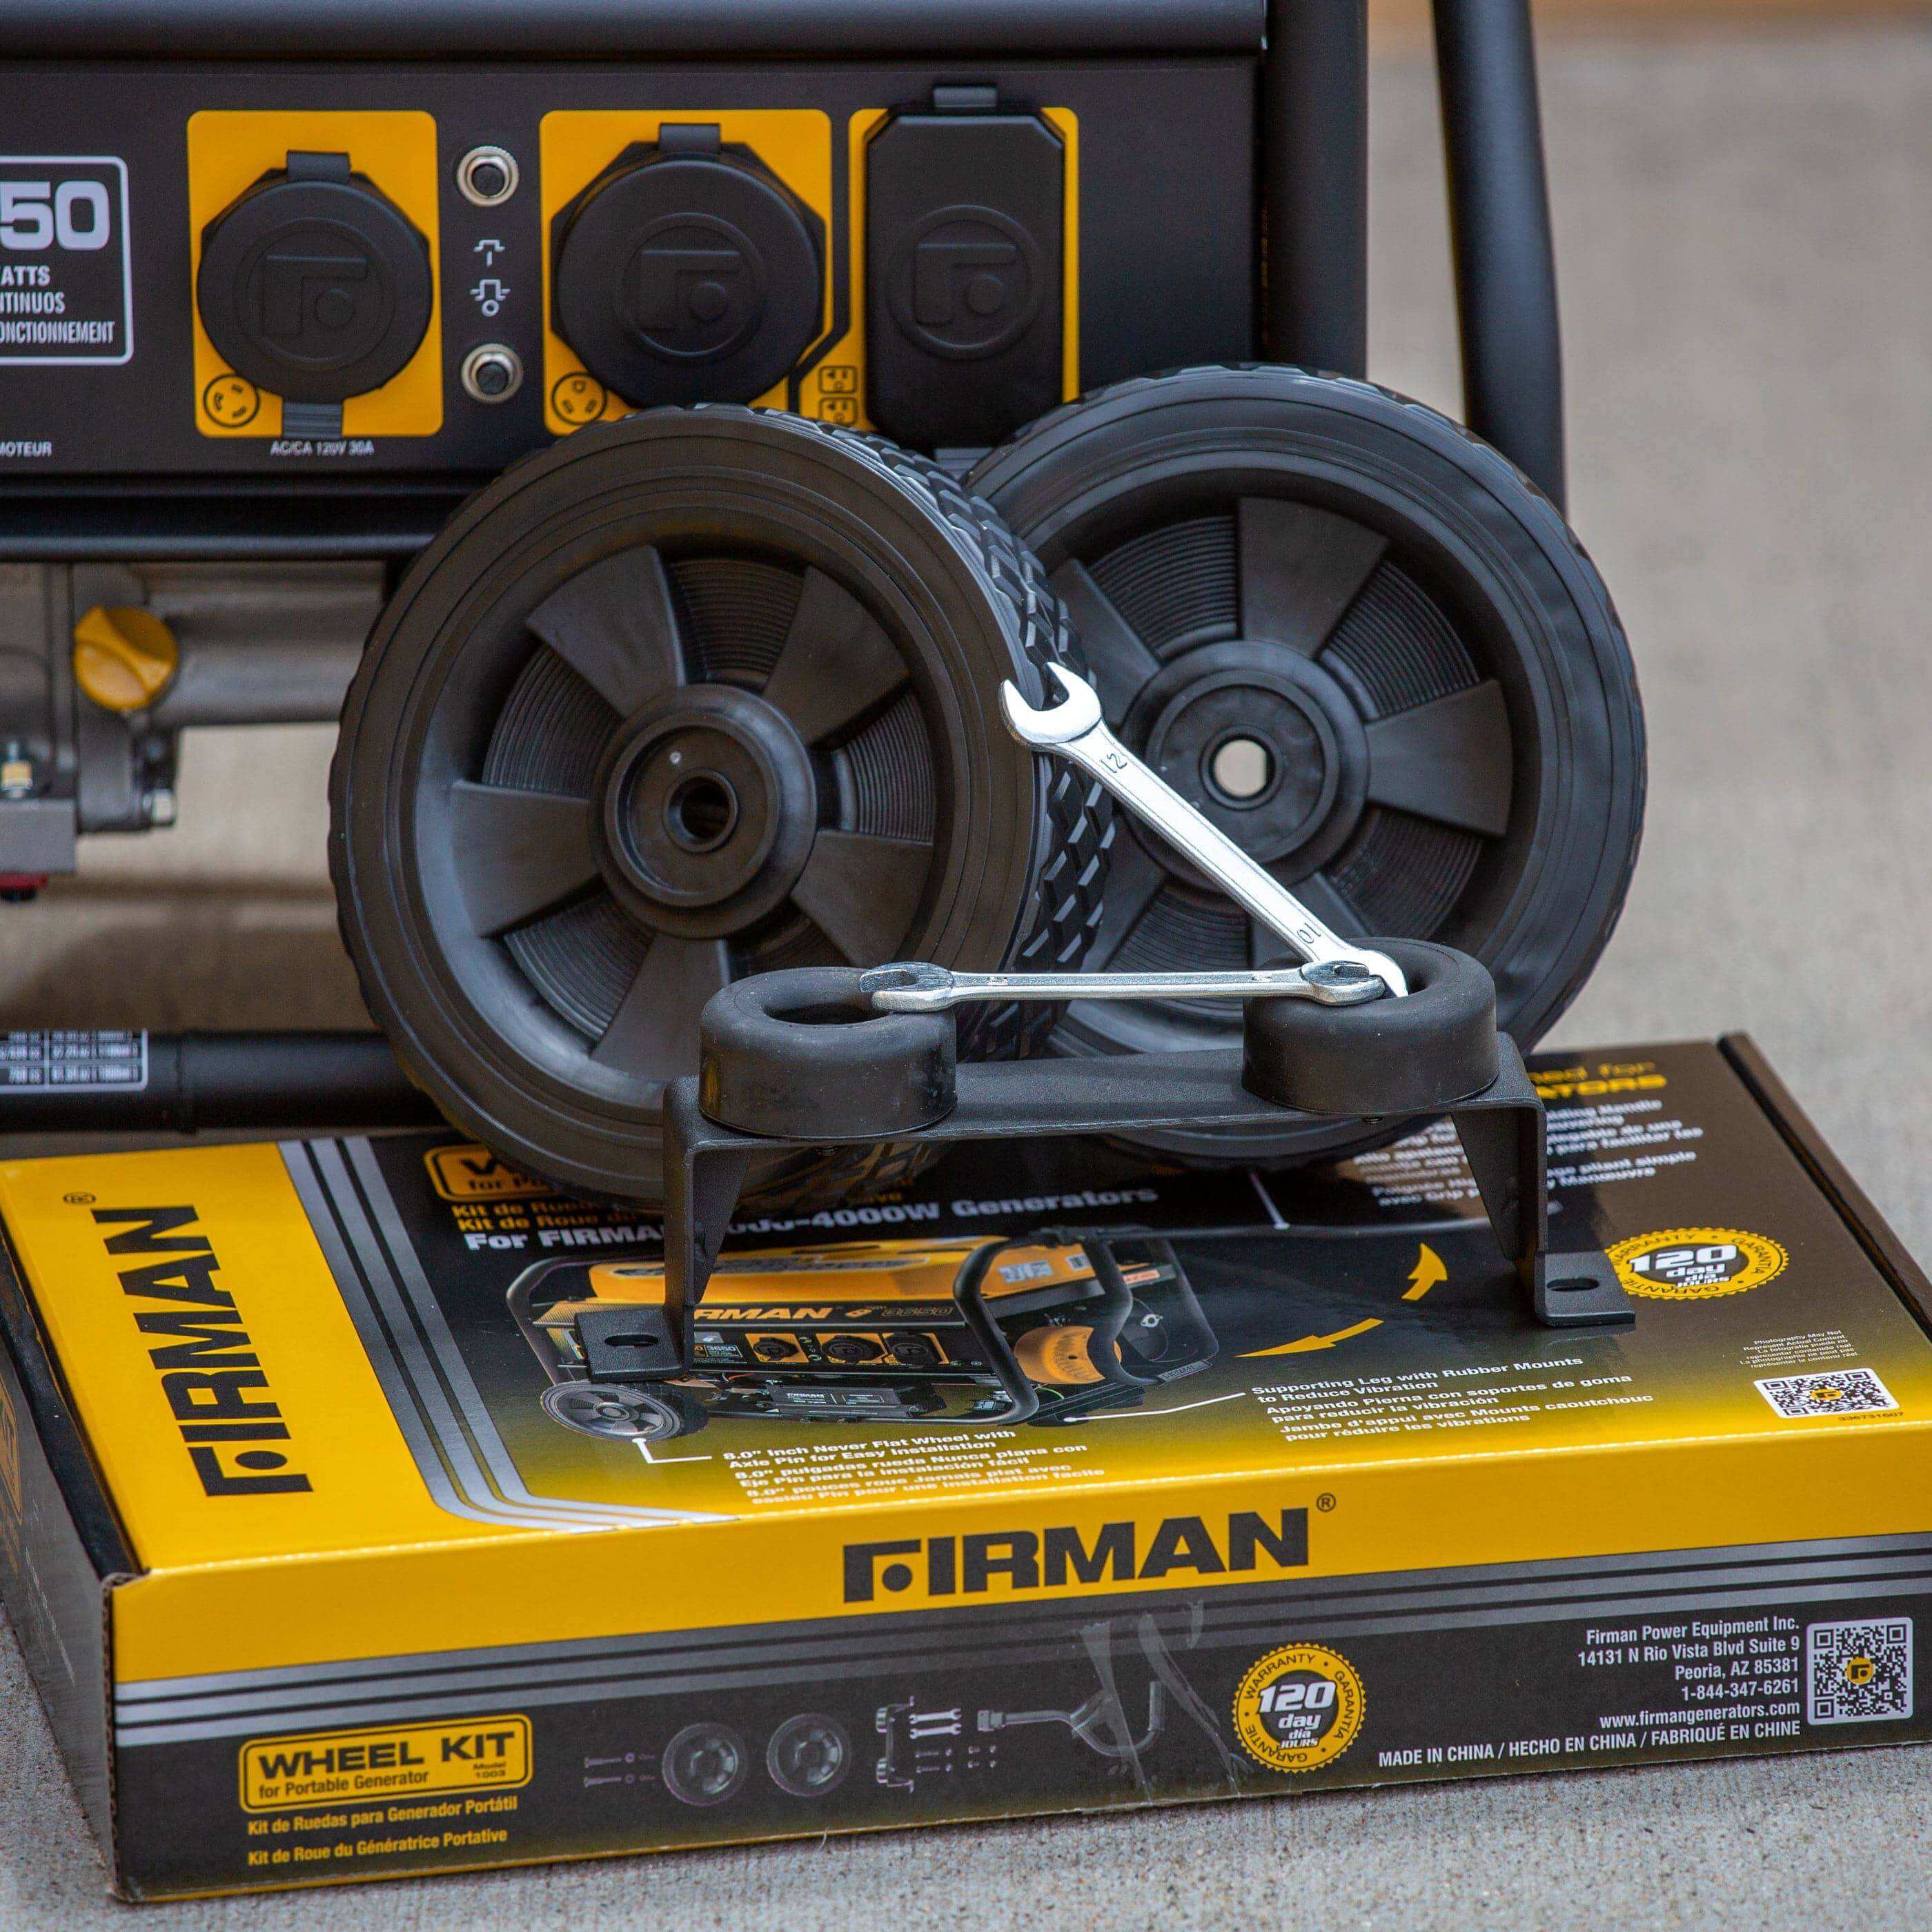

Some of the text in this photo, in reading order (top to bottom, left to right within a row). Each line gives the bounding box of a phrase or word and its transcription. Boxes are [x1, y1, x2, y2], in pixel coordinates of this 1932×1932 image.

[0, 265, 50, 286] ATTS
[457, 1218, 495, 1232] Kit
[463, 1187, 1159, 1251] For FIRMA Generators
[1628, 1244, 1737, 1272] 120
[1666, 1263, 1725, 1277] day
[91, 1205, 313, 1497] FIRMAN
[1743, 1342, 1784, 1351] Represent
[1754, 1334, 1806, 1346] Photography
[1252, 1357, 1584, 1394] Supporting Leg with Rubber Mounts
[1256, 1381, 1439, 1403] to Reduce Vibration
[1267, 1375, 1633, 1414] Apoyando Pierna con soportes de goma
[1272, 1414, 1314, 1424] para
[1319, 1407, 1385, 1419] reducir
[1412, 1397, 1499, 1410] vibración
[1280, 1421, 1343, 1434] Jambe
[1422, 1410, 1466, 1421] avec
[1470, 1404, 1541, 1416] Mounts
[1545, 1394, 1654, 1410] caoutchouc
[1285, 1414, 1530, 1442] pour réduire les vibrations
[729, 1441, 996, 1469] Axle Pin for Easy Installation
[767, 1446, 809, 1457] Inch
[813, 1442, 867, 1453] Never
[871, 1437, 909, 1448] Flat
[911, 1435, 969, 1446] Wheel
[974, 1430, 1016, 1441] with
[780, 1443, 1088, 1477] pulgadas rueda Nunca plana con
[773, 1476, 805, 1485] Pin
[809, 1471, 853, 1482] para
[791, 1464, 1072, 1495] pouces roue Jamais plat avec
[844, 1507, 1309, 1603] FIRMAN
[1586, 1615, 1800, 1646] Firman Power Equipment Inc.
[1578, 1636, 1800, 1667] 14131 N Rio Vista Blvd Suite 9
[1244, 1653, 1316, 1699] WARRANTY
[1675, 1657, 1799, 1682] Peoria, AZ 85381
[1259, 1681, 1337, 1713] 120
[1681, 1677, 1799, 1702] 1-844-347-6261
[1278, 1713, 1321, 1731] day
[1599, 1702, 1800, 1729] www.firmangenerators.com
[259, 1731, 514, 1780] WHEEL KIT
[1245, 1724, 1308, 1763] GARANTIE
[1279, 1738, 1319, 1749] JOURS
[1379, 1749, 1423, 1768] MADE
[1427, 1748, 1442, 1763] IN
[1447, 1744, 1495, 1762] CHINA
[1508, 1738, 1561, 1757] HECHO
[1565, 1736, 1585, 1753] EN
[1589, 1733, 1635, 1751] CHINA
[1651, 1722, 1726, 1746] FABRIQUÉ
[1730, 1724, 1750, 1742] EN
[1755, 1720, 1801, 1738] CHINE
[259, 1771, 428, 1799] for Portable Generator
[248, 1795, 518, 1835] Kit de Ruedas para Generador Portátil
[248, 1828, 508, 1866] Kit de Roue du Génératrice Portative
